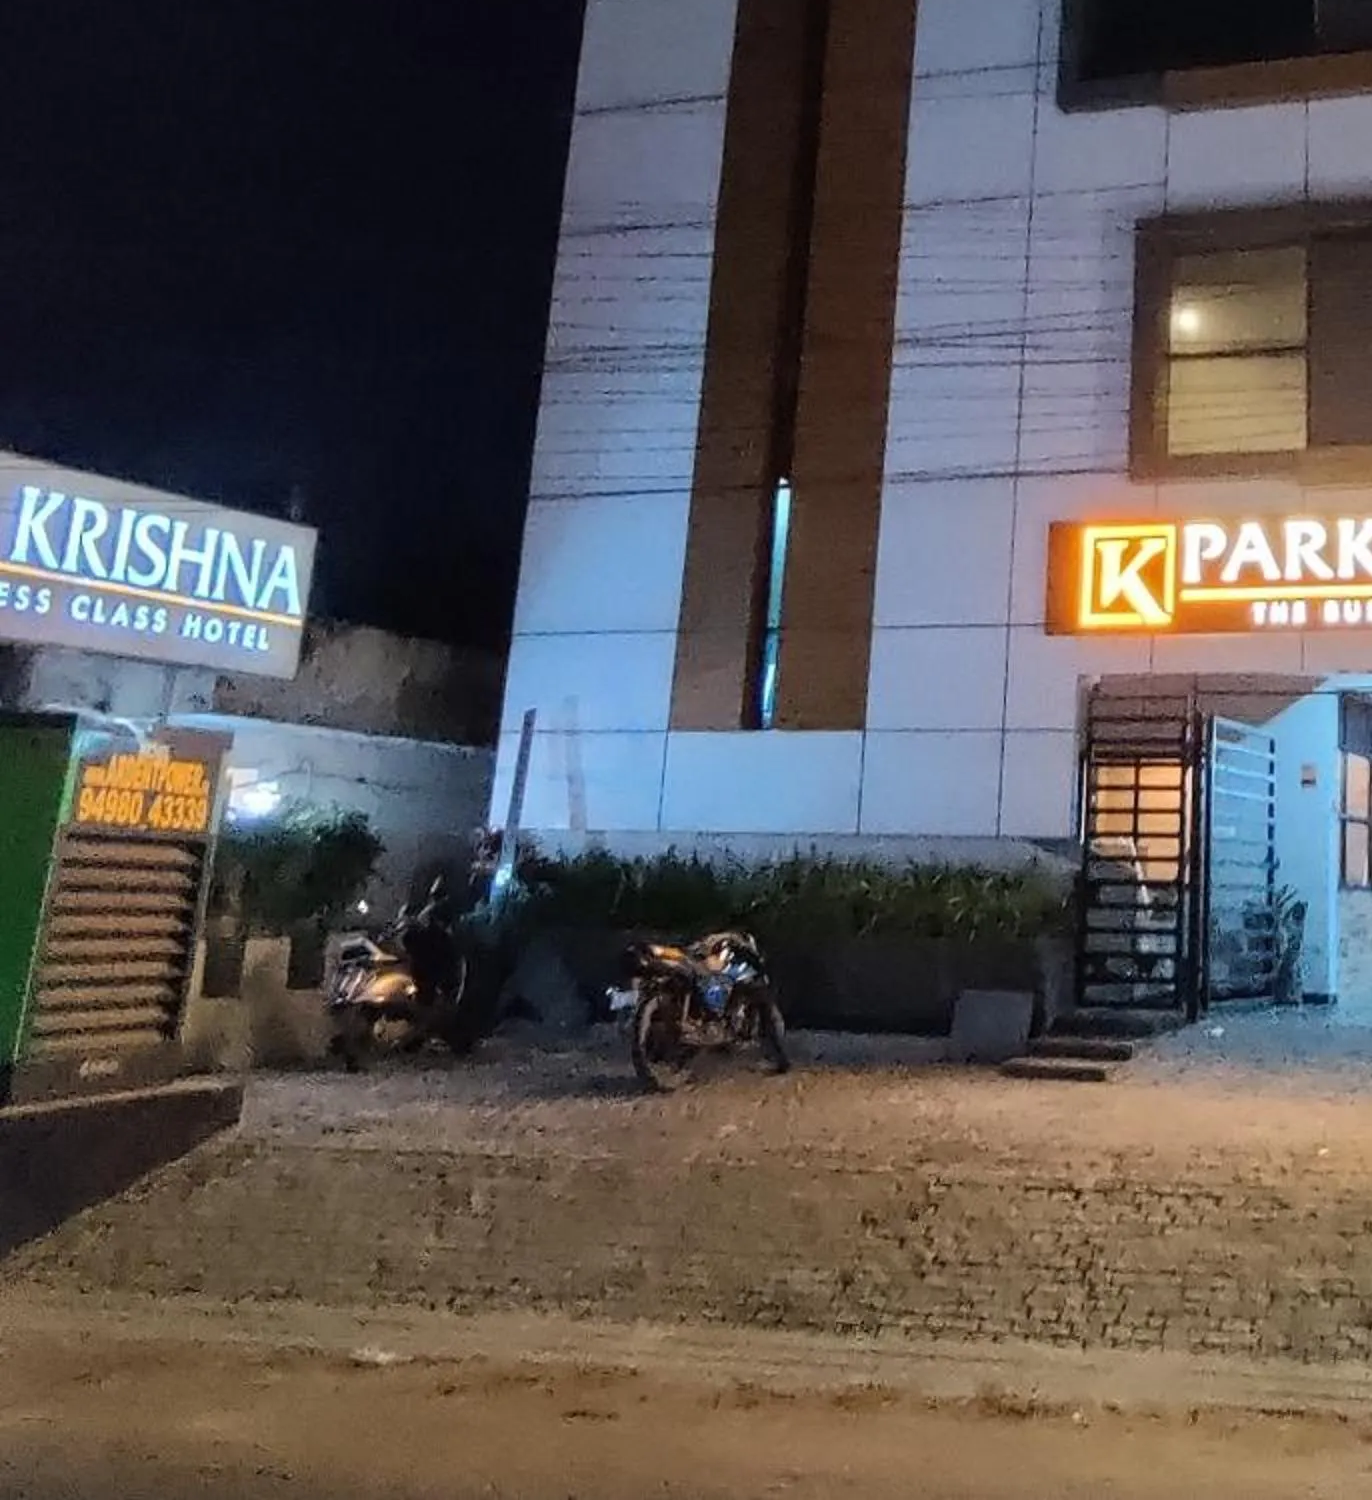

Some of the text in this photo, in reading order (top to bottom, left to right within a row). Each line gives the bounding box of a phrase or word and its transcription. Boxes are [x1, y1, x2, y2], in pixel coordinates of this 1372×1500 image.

[10, 486, 302, 616] KRISHNA
[1097, 536, 1172, 624] K
[70, 595, 169, 634] CLASS
[180, 613, 270, 651] HOTEL
[1250, 600, 1307, 626] THE
